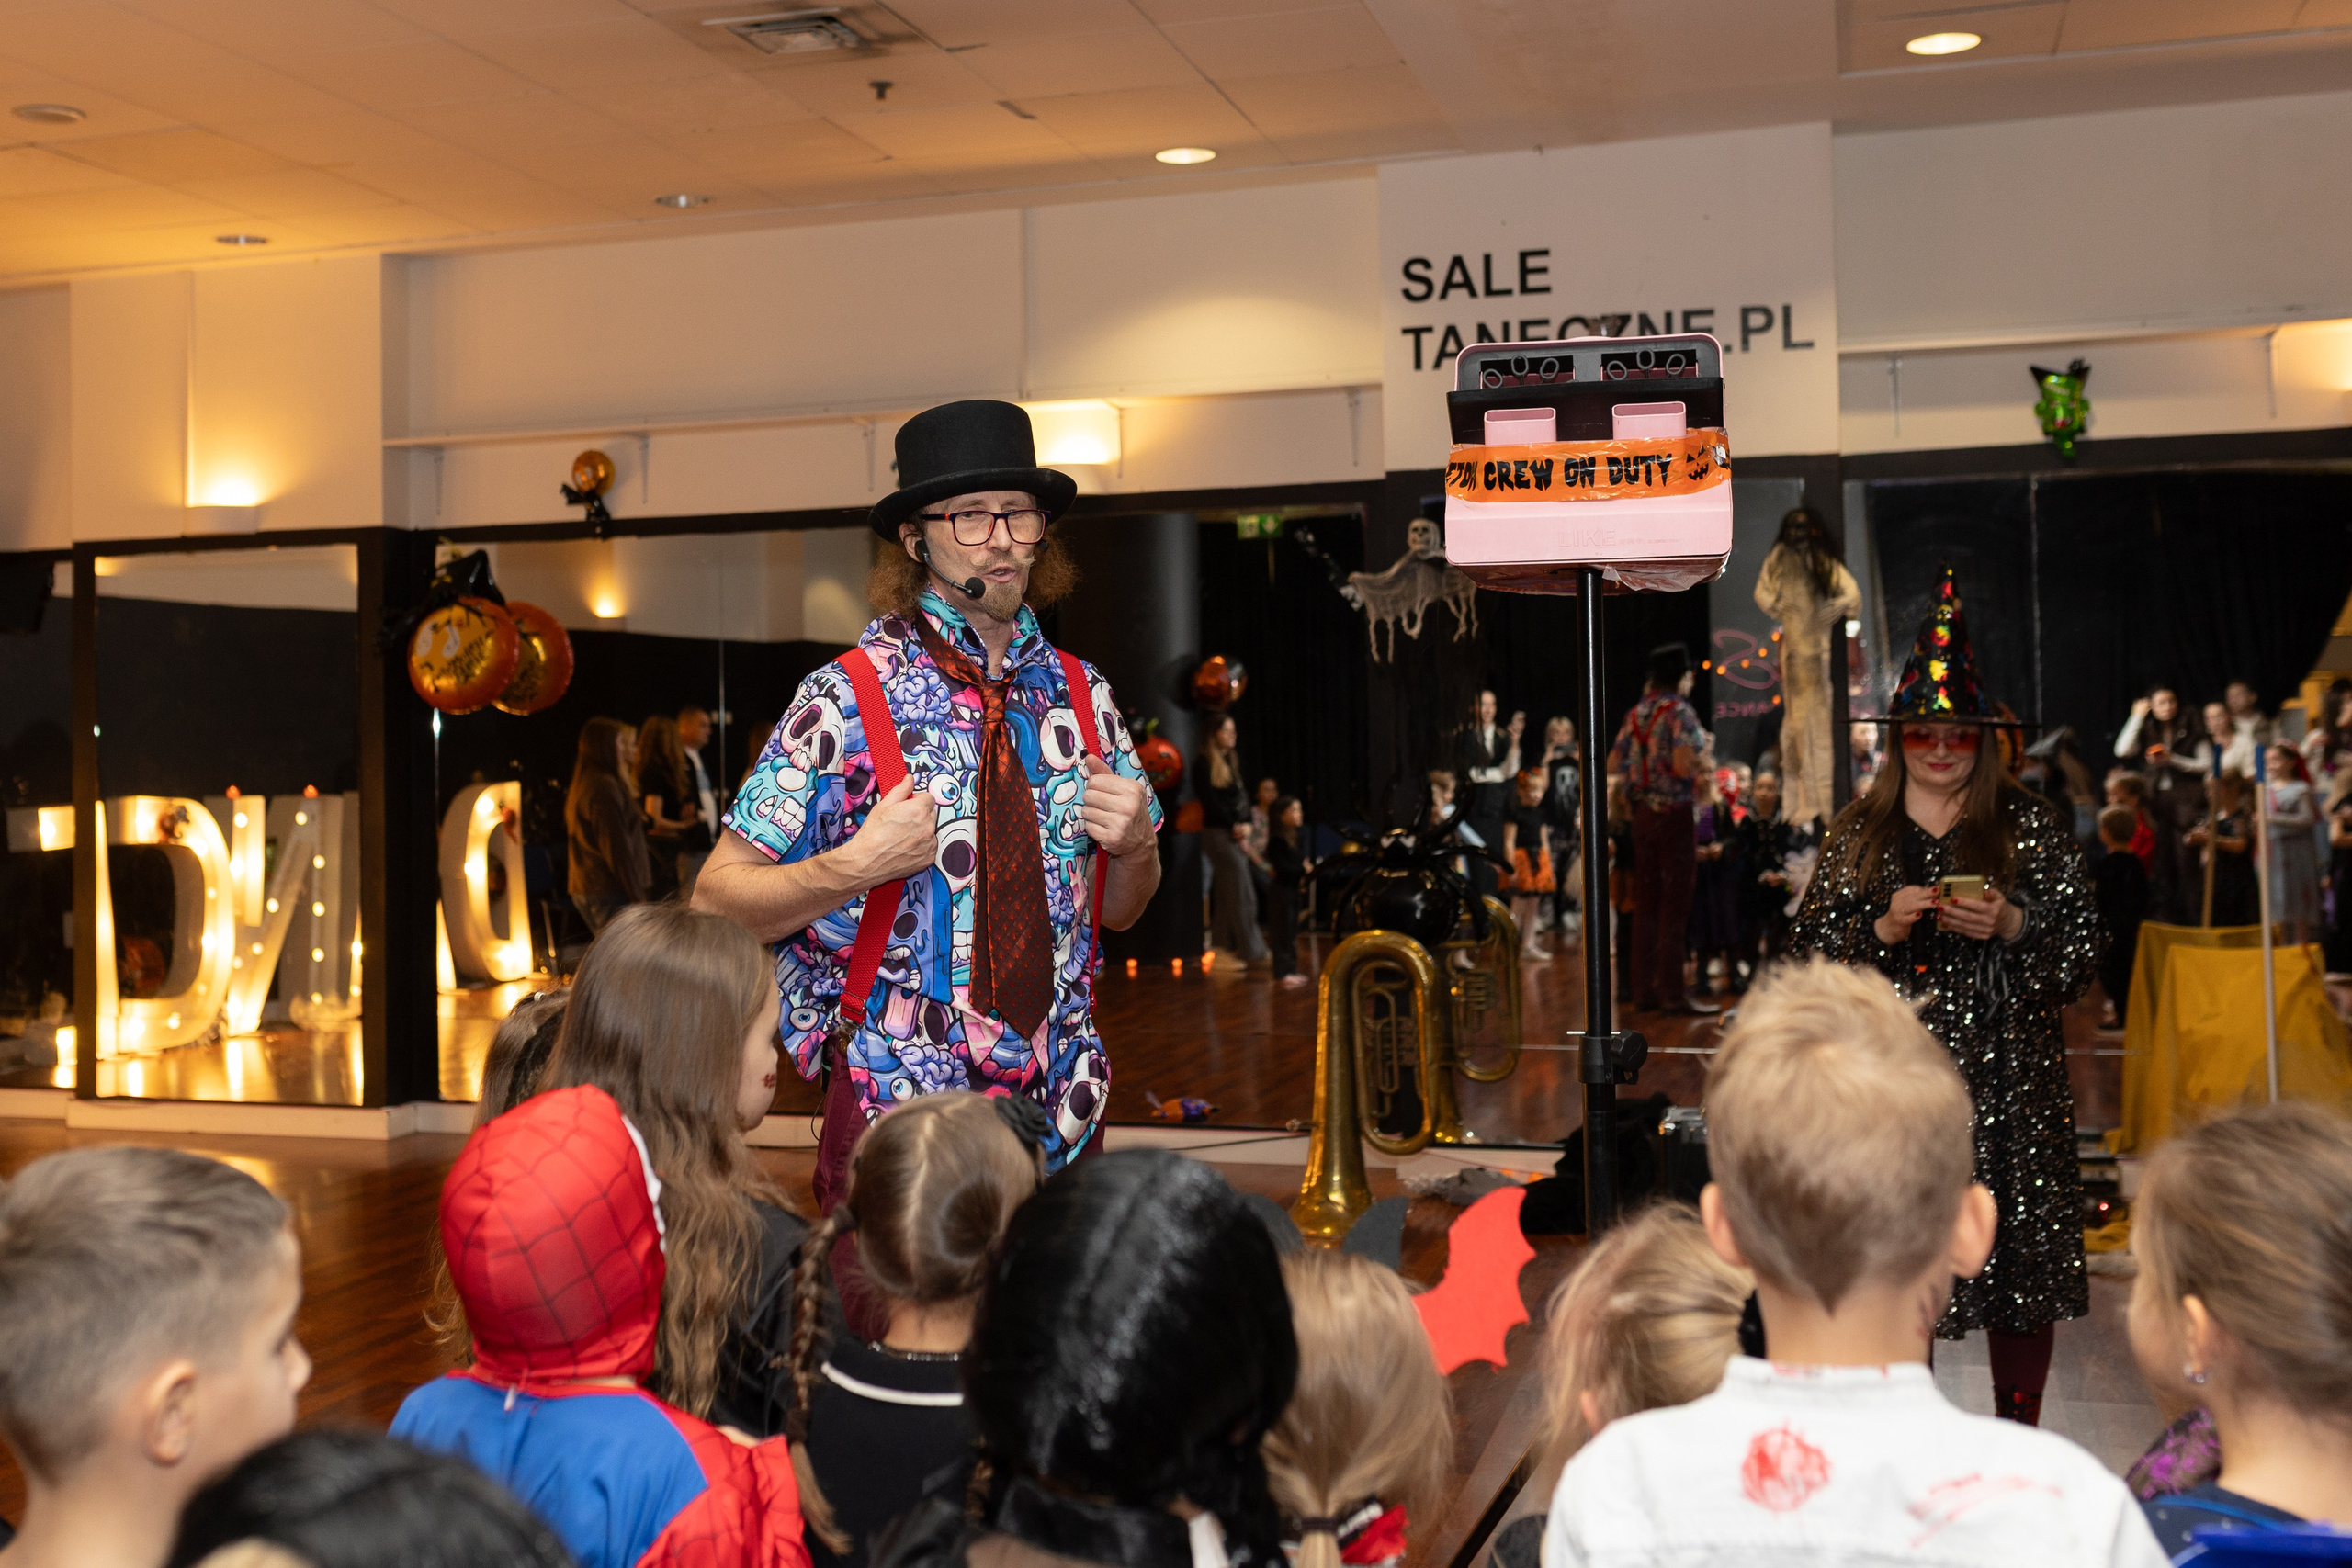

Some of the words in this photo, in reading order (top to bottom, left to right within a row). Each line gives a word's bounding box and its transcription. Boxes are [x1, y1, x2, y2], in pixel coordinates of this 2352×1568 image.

[1401, 248, 1552, 302] SALE
[1483, 458, 1554, 492] CREW
[1564, 457, 1596, 489] ON
[1606, 453, 1672, 488] DUTY
[1558, 528, 1616, 548] LIKE
